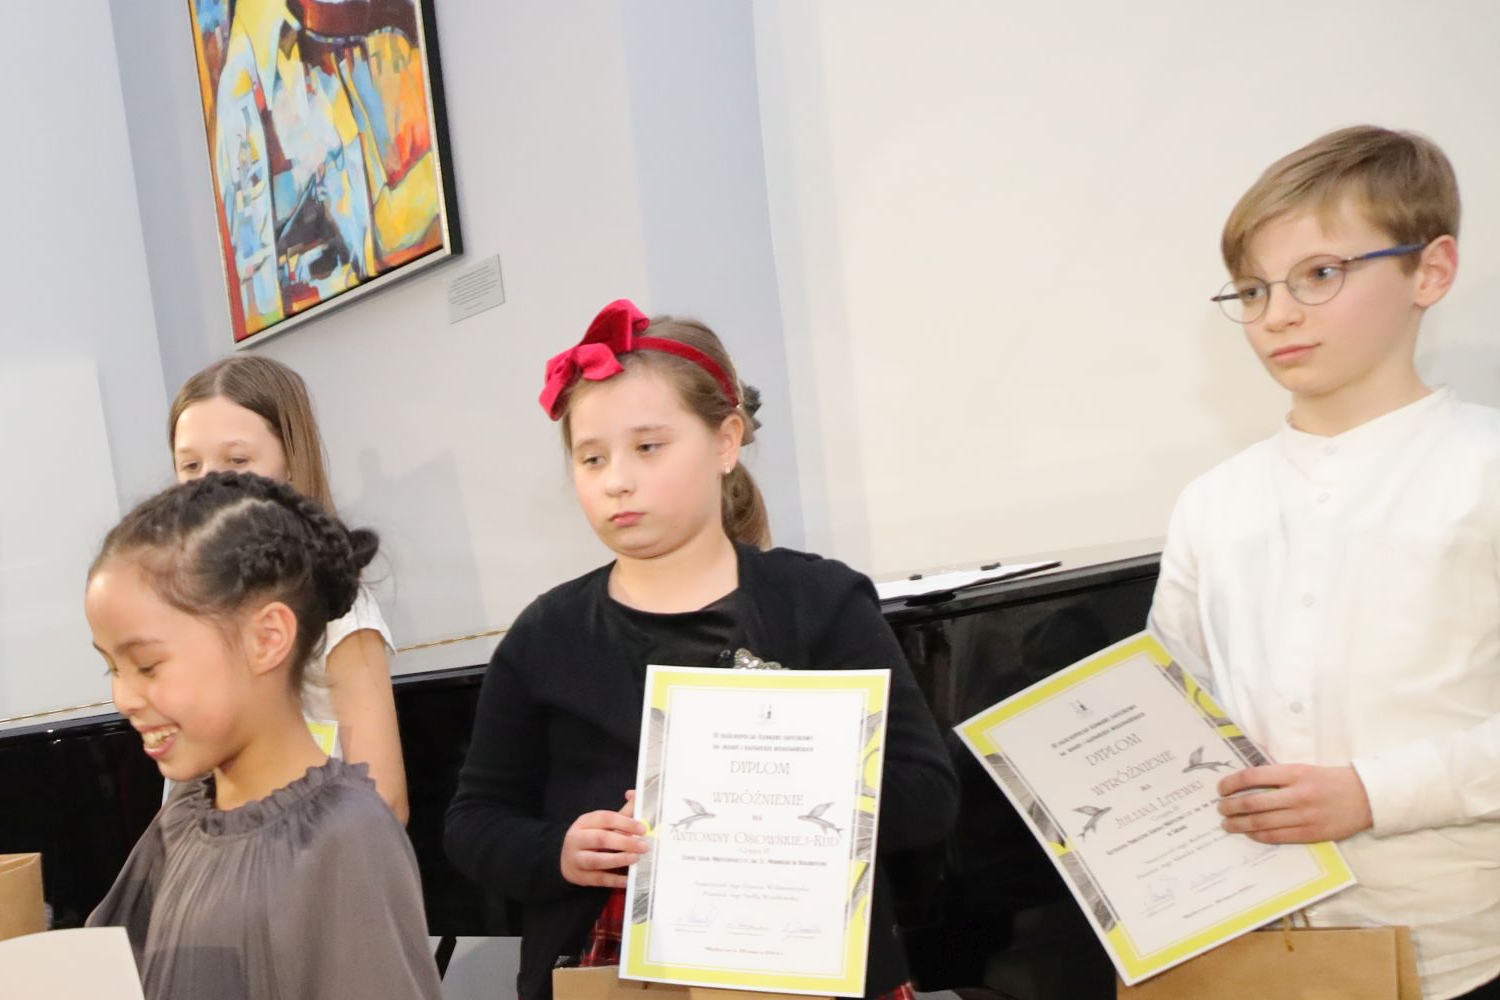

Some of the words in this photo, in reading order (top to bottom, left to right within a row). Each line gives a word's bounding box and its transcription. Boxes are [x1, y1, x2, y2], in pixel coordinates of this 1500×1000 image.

[1085, 732, 1143, 767] DYPLOM
[730, 760, 790, 775] DYPLOM
[713, 789, 804, 806] WYRÓŻNIENIE
